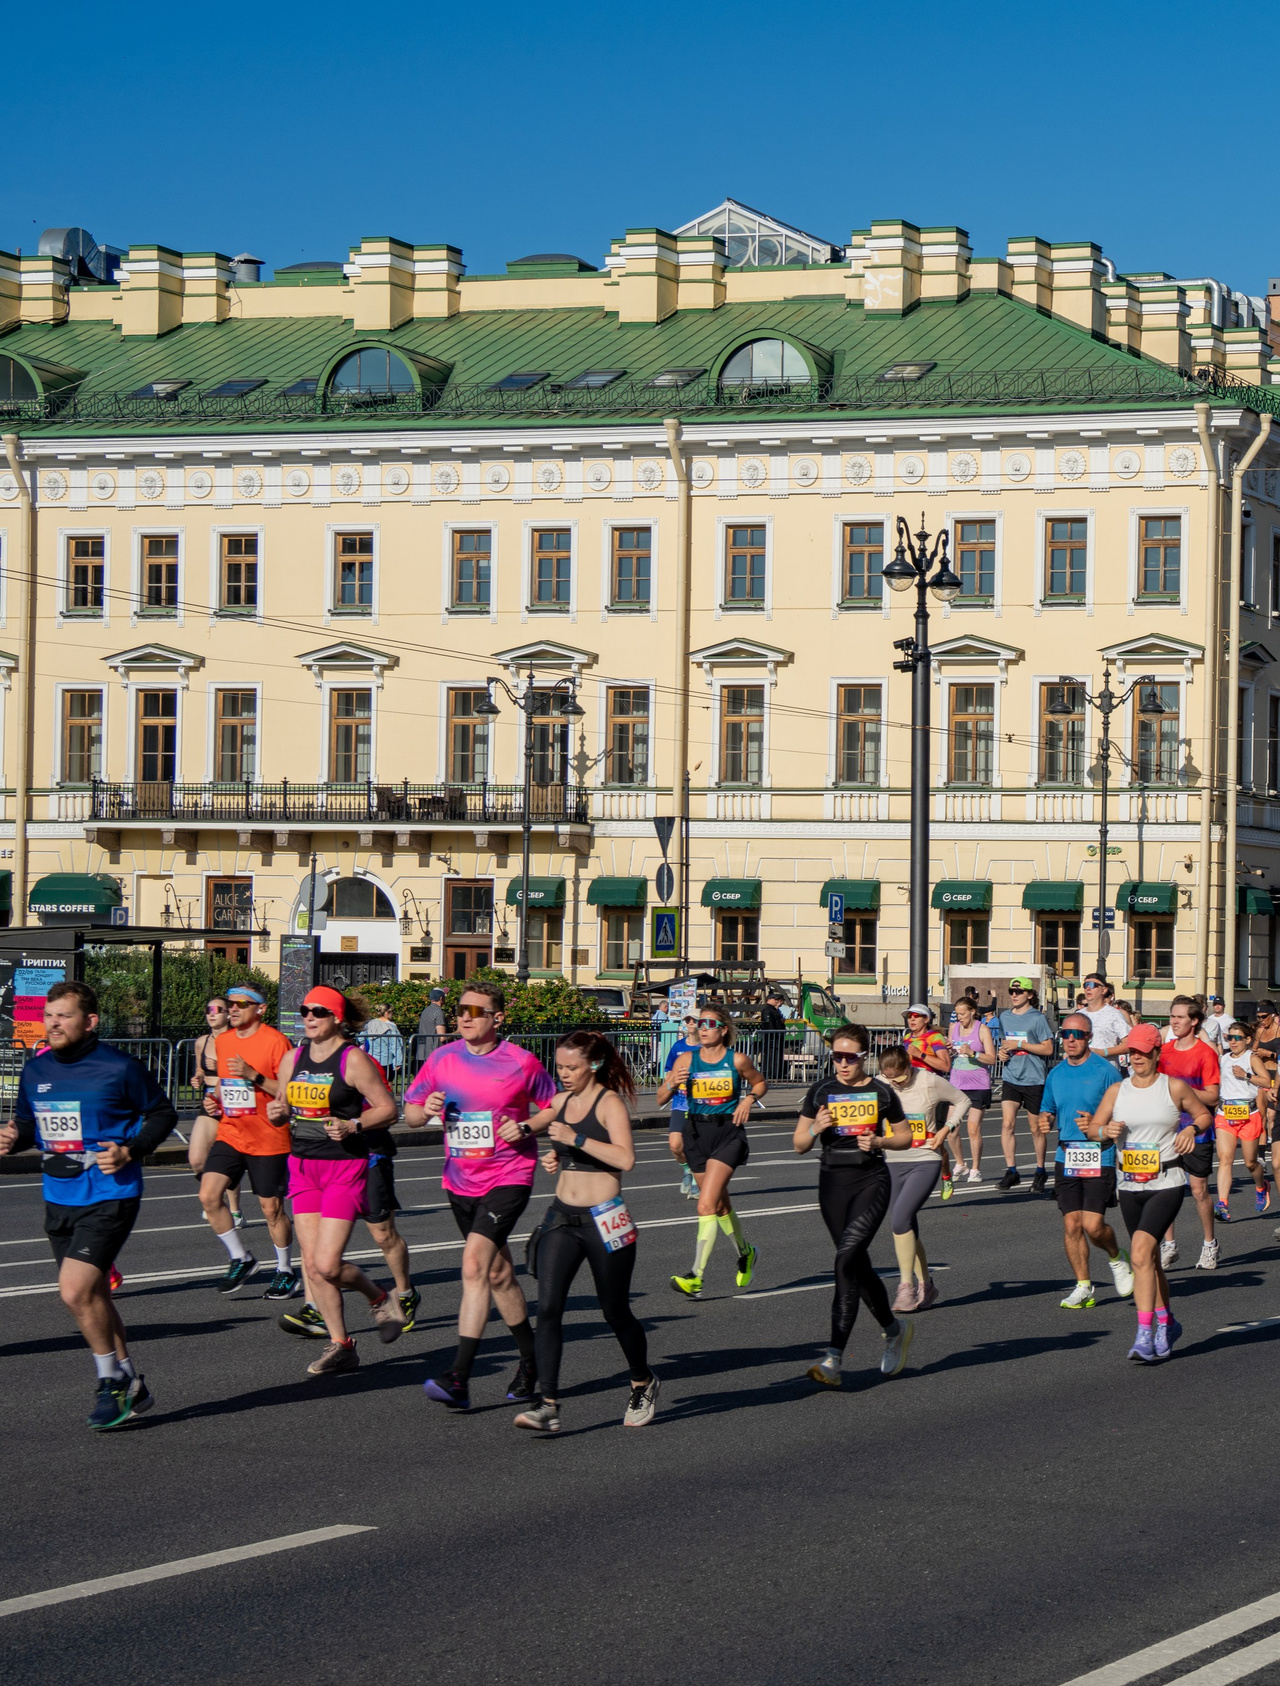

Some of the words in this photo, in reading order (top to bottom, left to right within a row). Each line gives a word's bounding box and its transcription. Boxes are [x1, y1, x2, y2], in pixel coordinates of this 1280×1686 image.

[214, 893, 239, 906] ALICE
[953, 894, 972, 902] СБЕР
[1138, 896, 1158, 904] СБЕР
[31, 904, 58, 912] STARS
[59, 904, 95, 912] COFFEE
[22, 958, 67, 967] ТРИПТИХ
[695, 1080, 730, 1093] 11468
[223, 1089, 249, 1101] 9570
[289, 1085, 326, 1101] 11106
[832, 1104, 875, 1118] 13200
[1224, 1107, 1248, 1116] 14356
[447, 1125, 491, 1140] 11830
[1067, 1151, 1099, 1162] 13338
[1123, 1153, 1157, 1166] 10684
[612, 1240, 620, 1249] D
